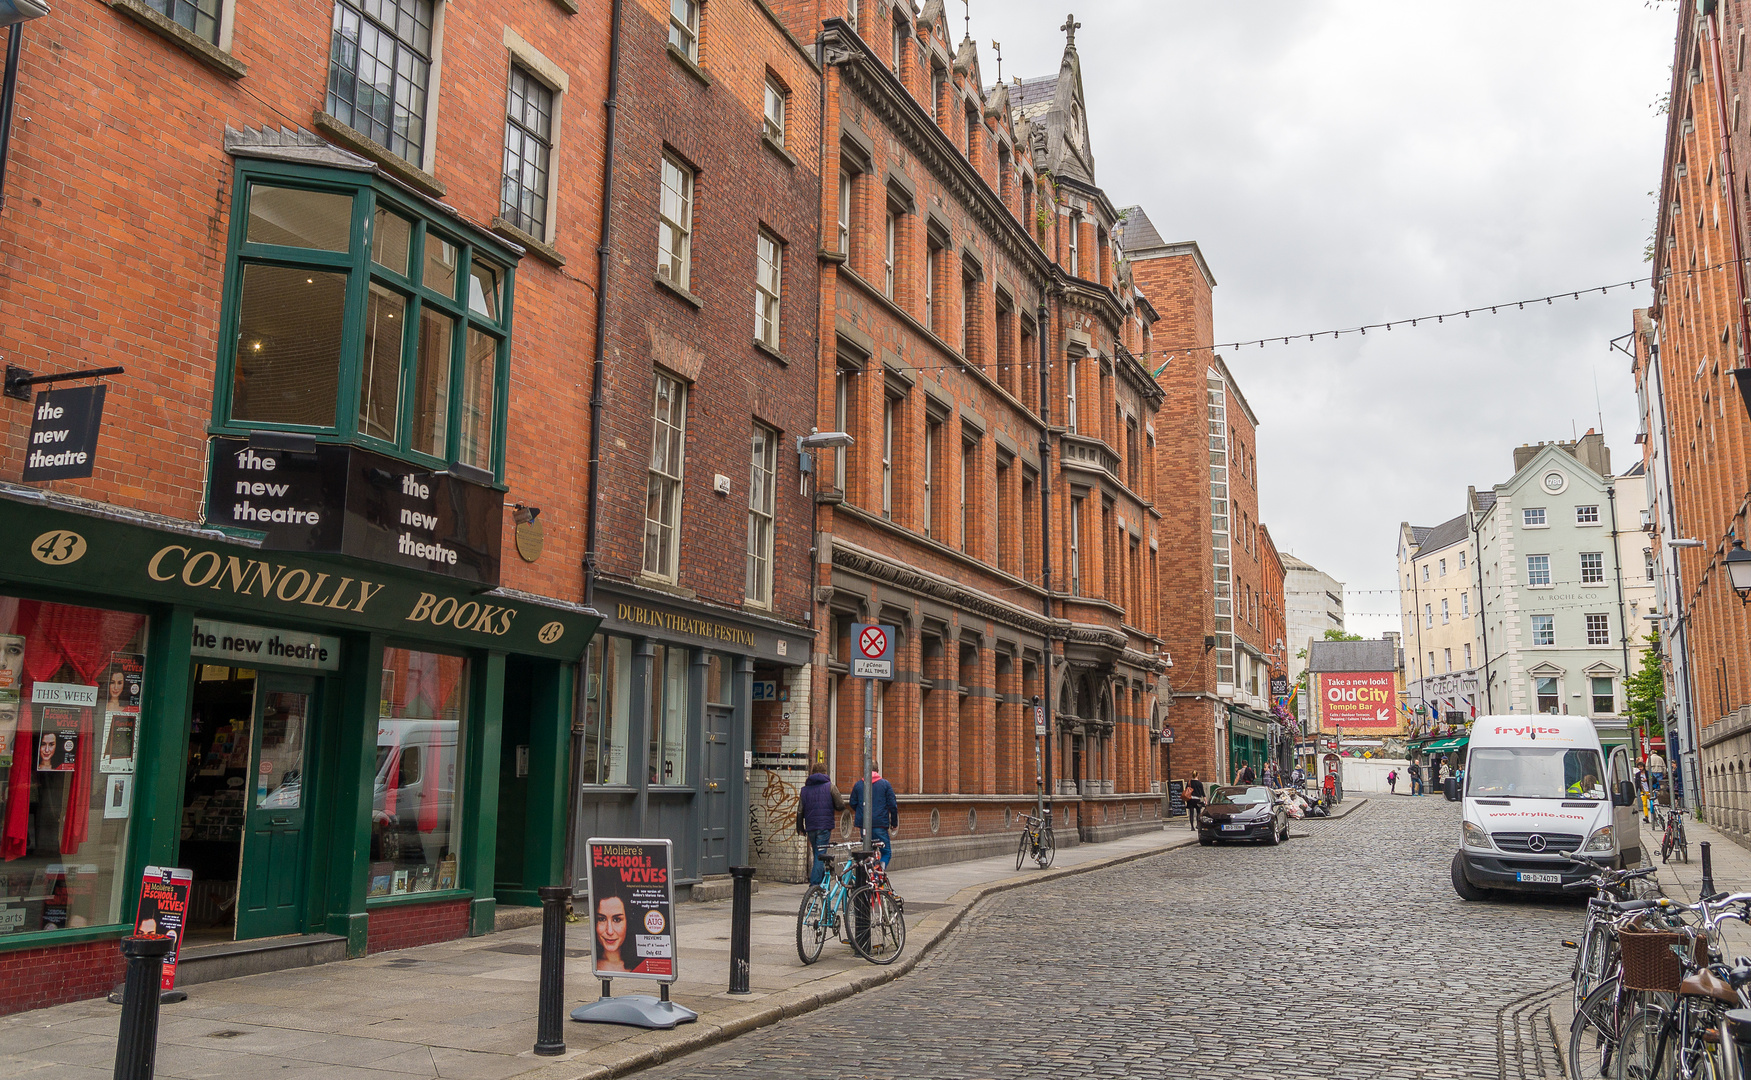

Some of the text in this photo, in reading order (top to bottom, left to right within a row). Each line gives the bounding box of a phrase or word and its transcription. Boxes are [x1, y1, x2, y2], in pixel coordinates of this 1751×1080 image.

[37, 402, 64, 420] the
[33, 429, 70, 444] new
[29, 449, 88, 468] theatre
[238, 450, 276, 471] the
[235, 480, 290, 498] new
[402, 473, 429, 500] the
[233, 500, 320, 525] theatre
[400, 508, 438, 531] new
[37, 532, 78, 561] 43
[398, 532, 458, 565] theatre
[147, 545, 518, 636] CONNOLLY BOOKS
[540, 623, 562, 641] 43
[617, 603, 757, 647] DUBLIN THEATRE FESTIVAL
[222, 635, 263, 654] new
[268, 633, 328, 662] theatre
[1327, 678, 1345, 686] Take
[1369, 677, 1388, 685] look!
[1432, 680, 1458, 696] CZECH
[1460, 678, 1475, 692] INN
[36, 688, 93, 703] THIS WEEK
[766, 683, 774, 698] 2
[1327, 687, 1389, 704] OldCity
[1328, 703, 1357, 712] Temple
[1494, 725, 1560, 736] frylite
[1489, 811, 1585, 821] www.frylite.com
[593, 845, 603, 868] THE
[603, 845, 643, 856] Molière's
[603, 855, 645, 868] SCHOOL
[620, 867, 667, 883] WIVES
[149, 890, 173, 900] SCHOOL
[157, 899, 184, 912] WIVES
[5, 913, 23, 923] arts
[647, 918, 663, 926] AUG
